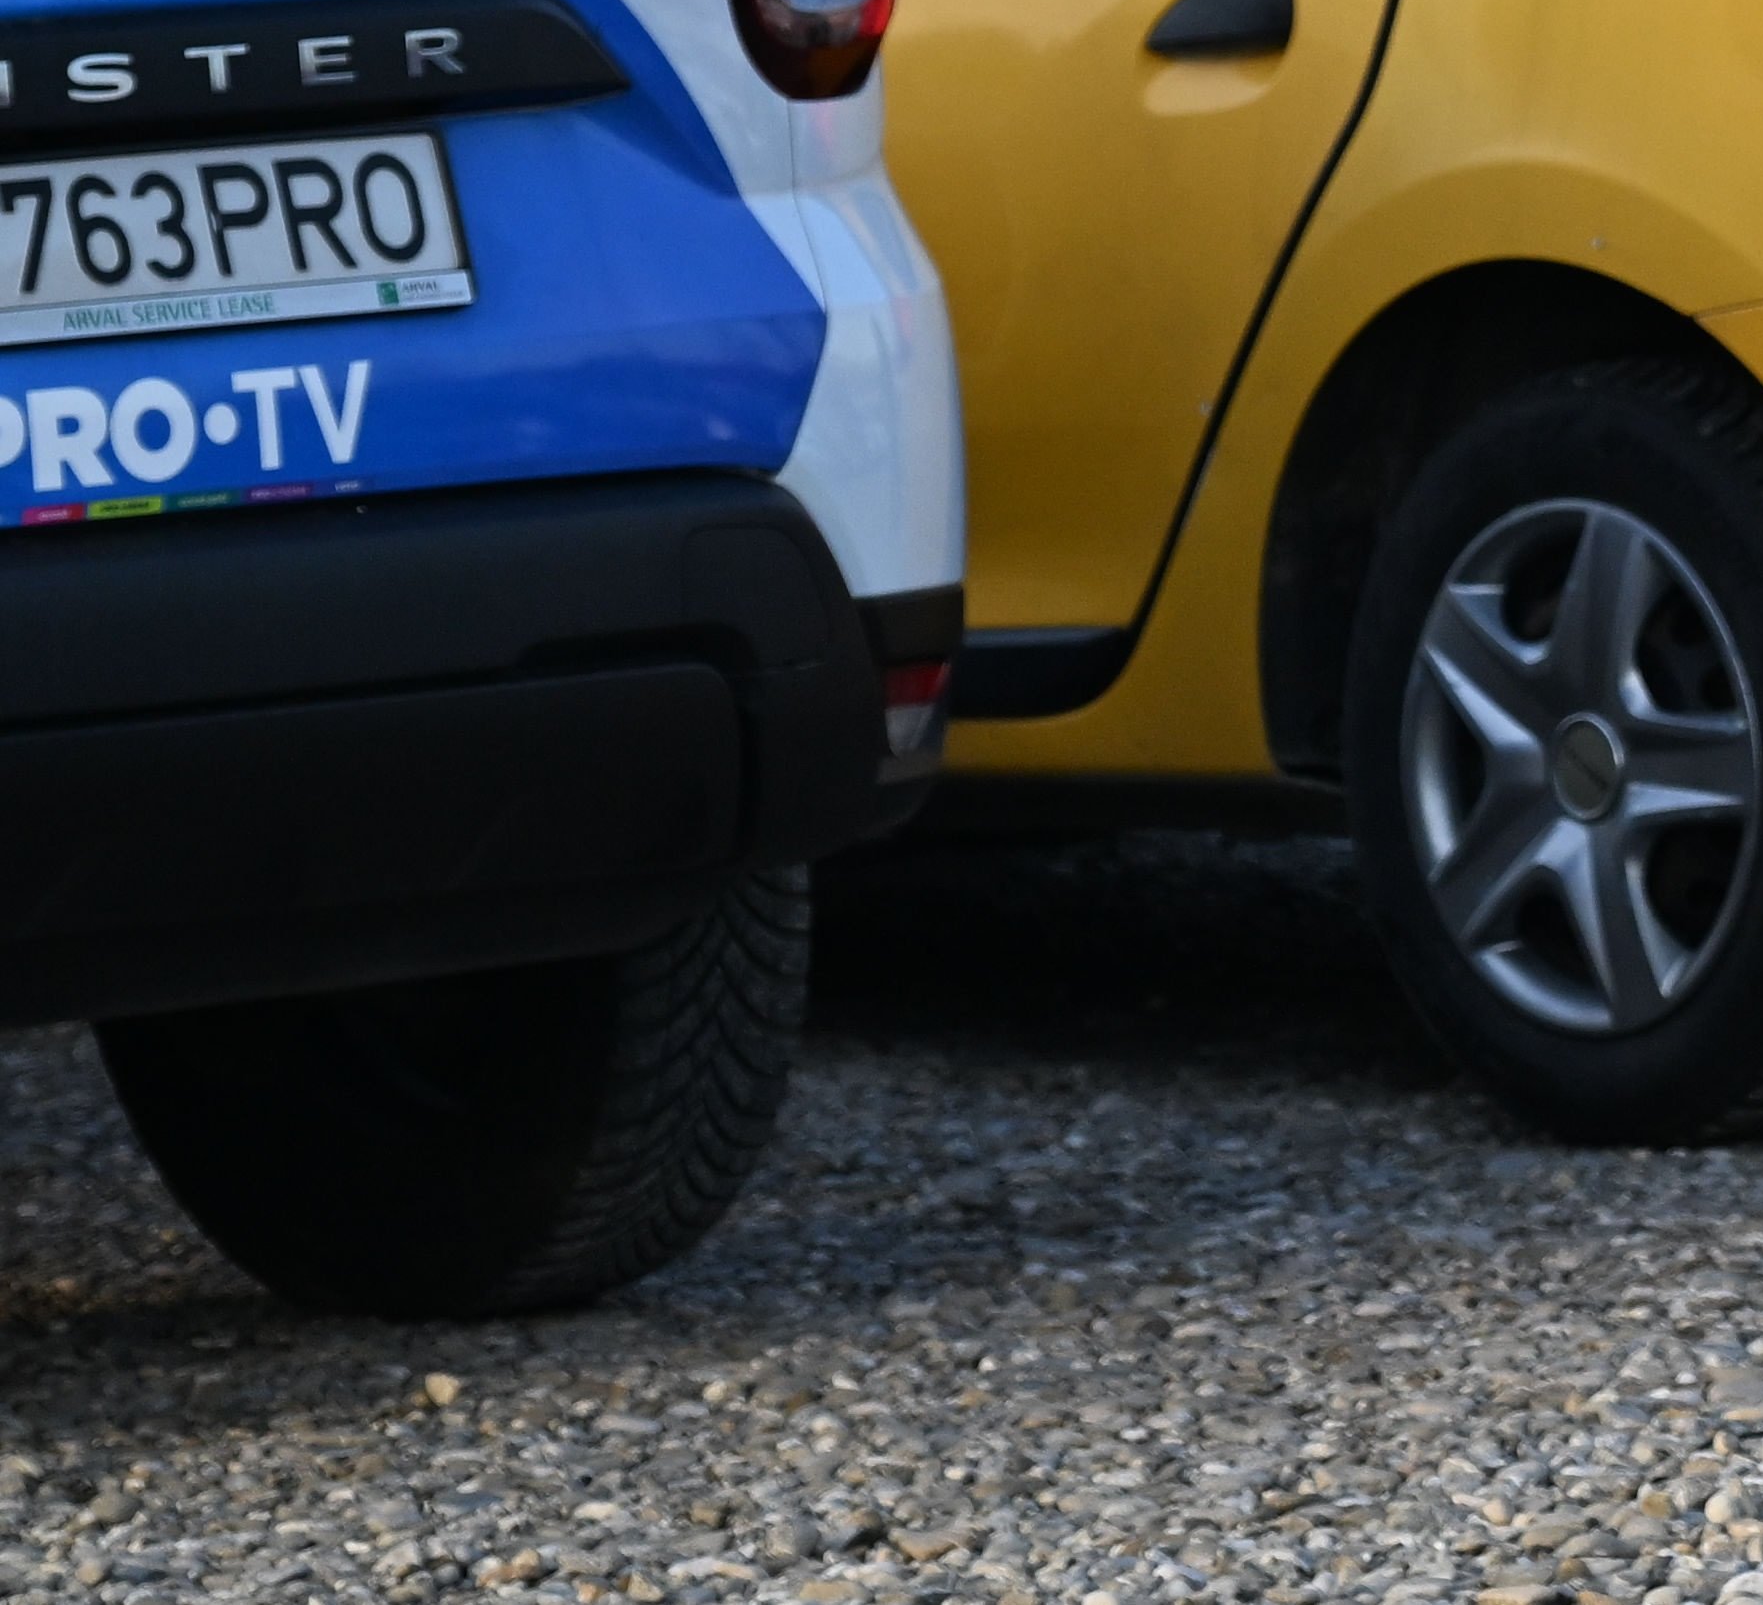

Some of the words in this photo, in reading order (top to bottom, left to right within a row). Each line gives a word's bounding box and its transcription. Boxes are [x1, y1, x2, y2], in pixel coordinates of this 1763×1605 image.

[0, 27, 467, 107] STER
[63, 307, 128, 332] ARVAL
[132, 297, 212, 324] SERVICE
[218, 292, 275, 317] LEASE
